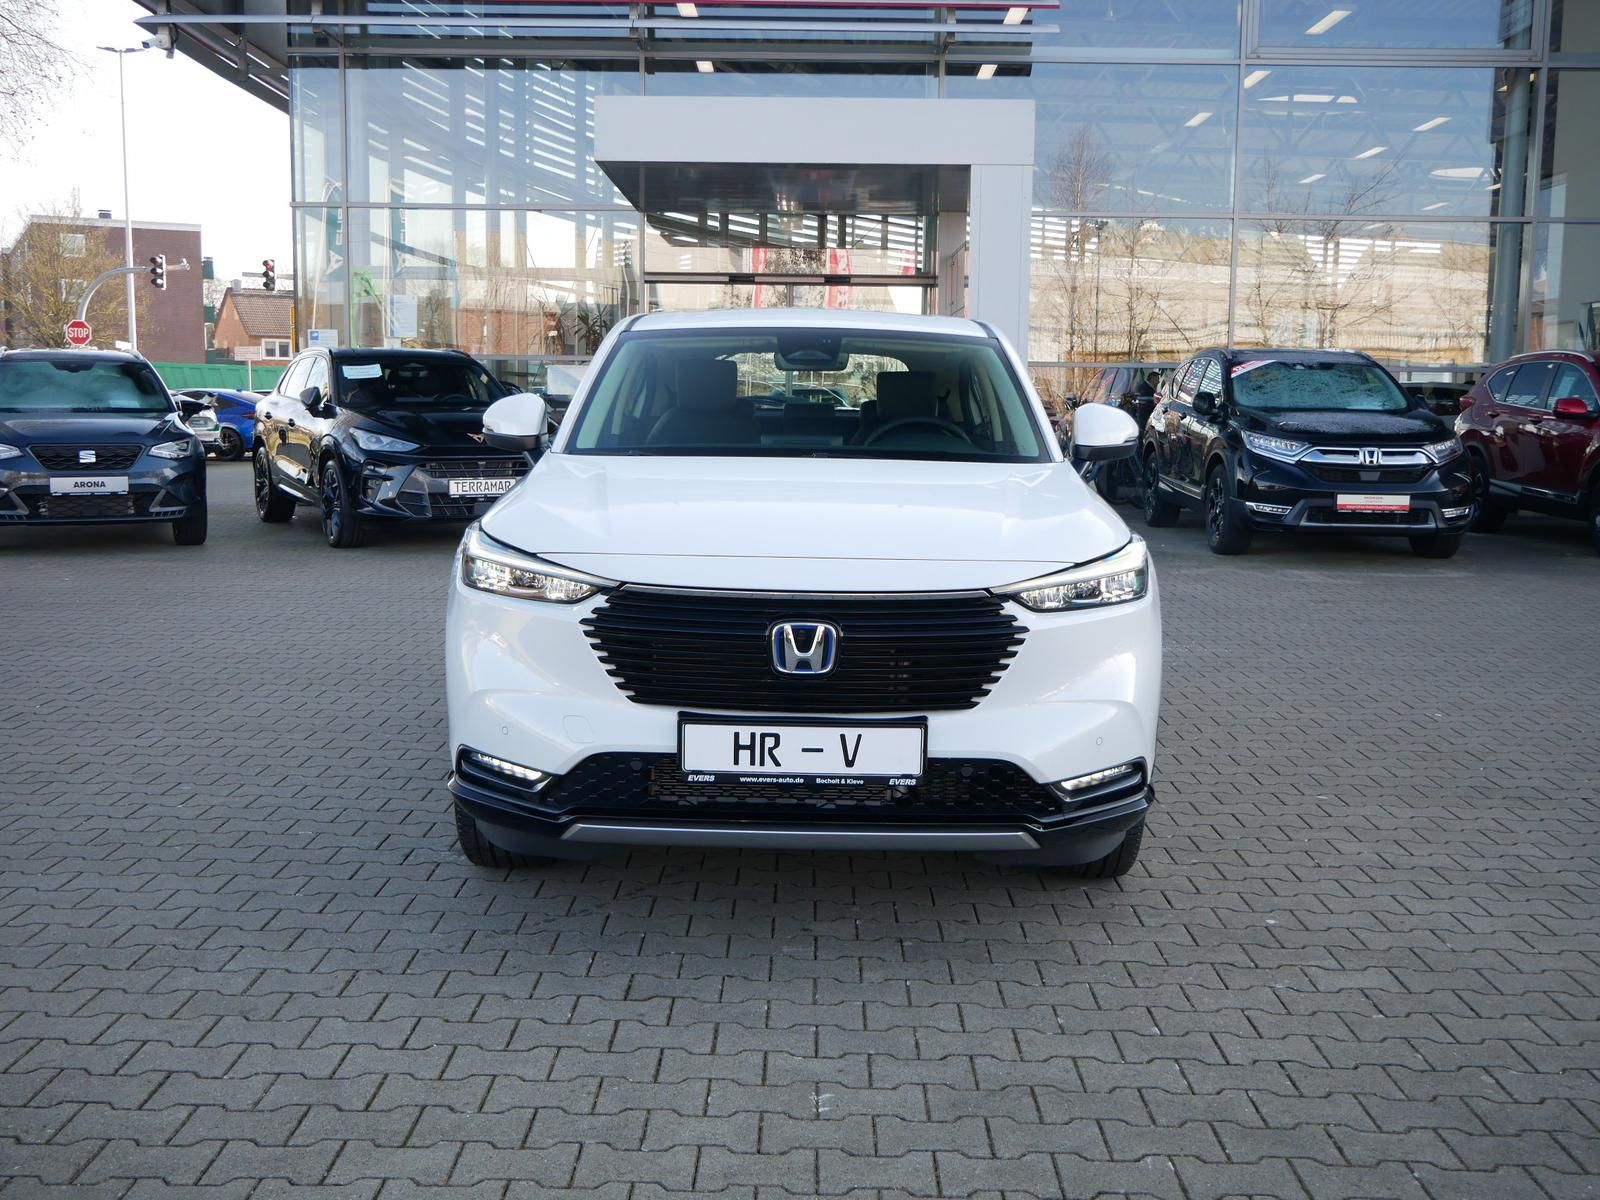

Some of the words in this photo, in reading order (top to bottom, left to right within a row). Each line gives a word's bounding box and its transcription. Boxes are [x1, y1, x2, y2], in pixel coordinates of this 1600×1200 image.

[68, 327, 89, 338] STOP
[454, 481, 511, 492] TERRAMAR
[733, 731, 782, 767] HR
[839, 733, 862, 768] V
[687, 774, 715, 782] EVERS
[739, 776, 804, 784] www.evers-auto.de
[815, 777, 840, 785] Bocholt
[888, 778, 917, 786] EVERS
